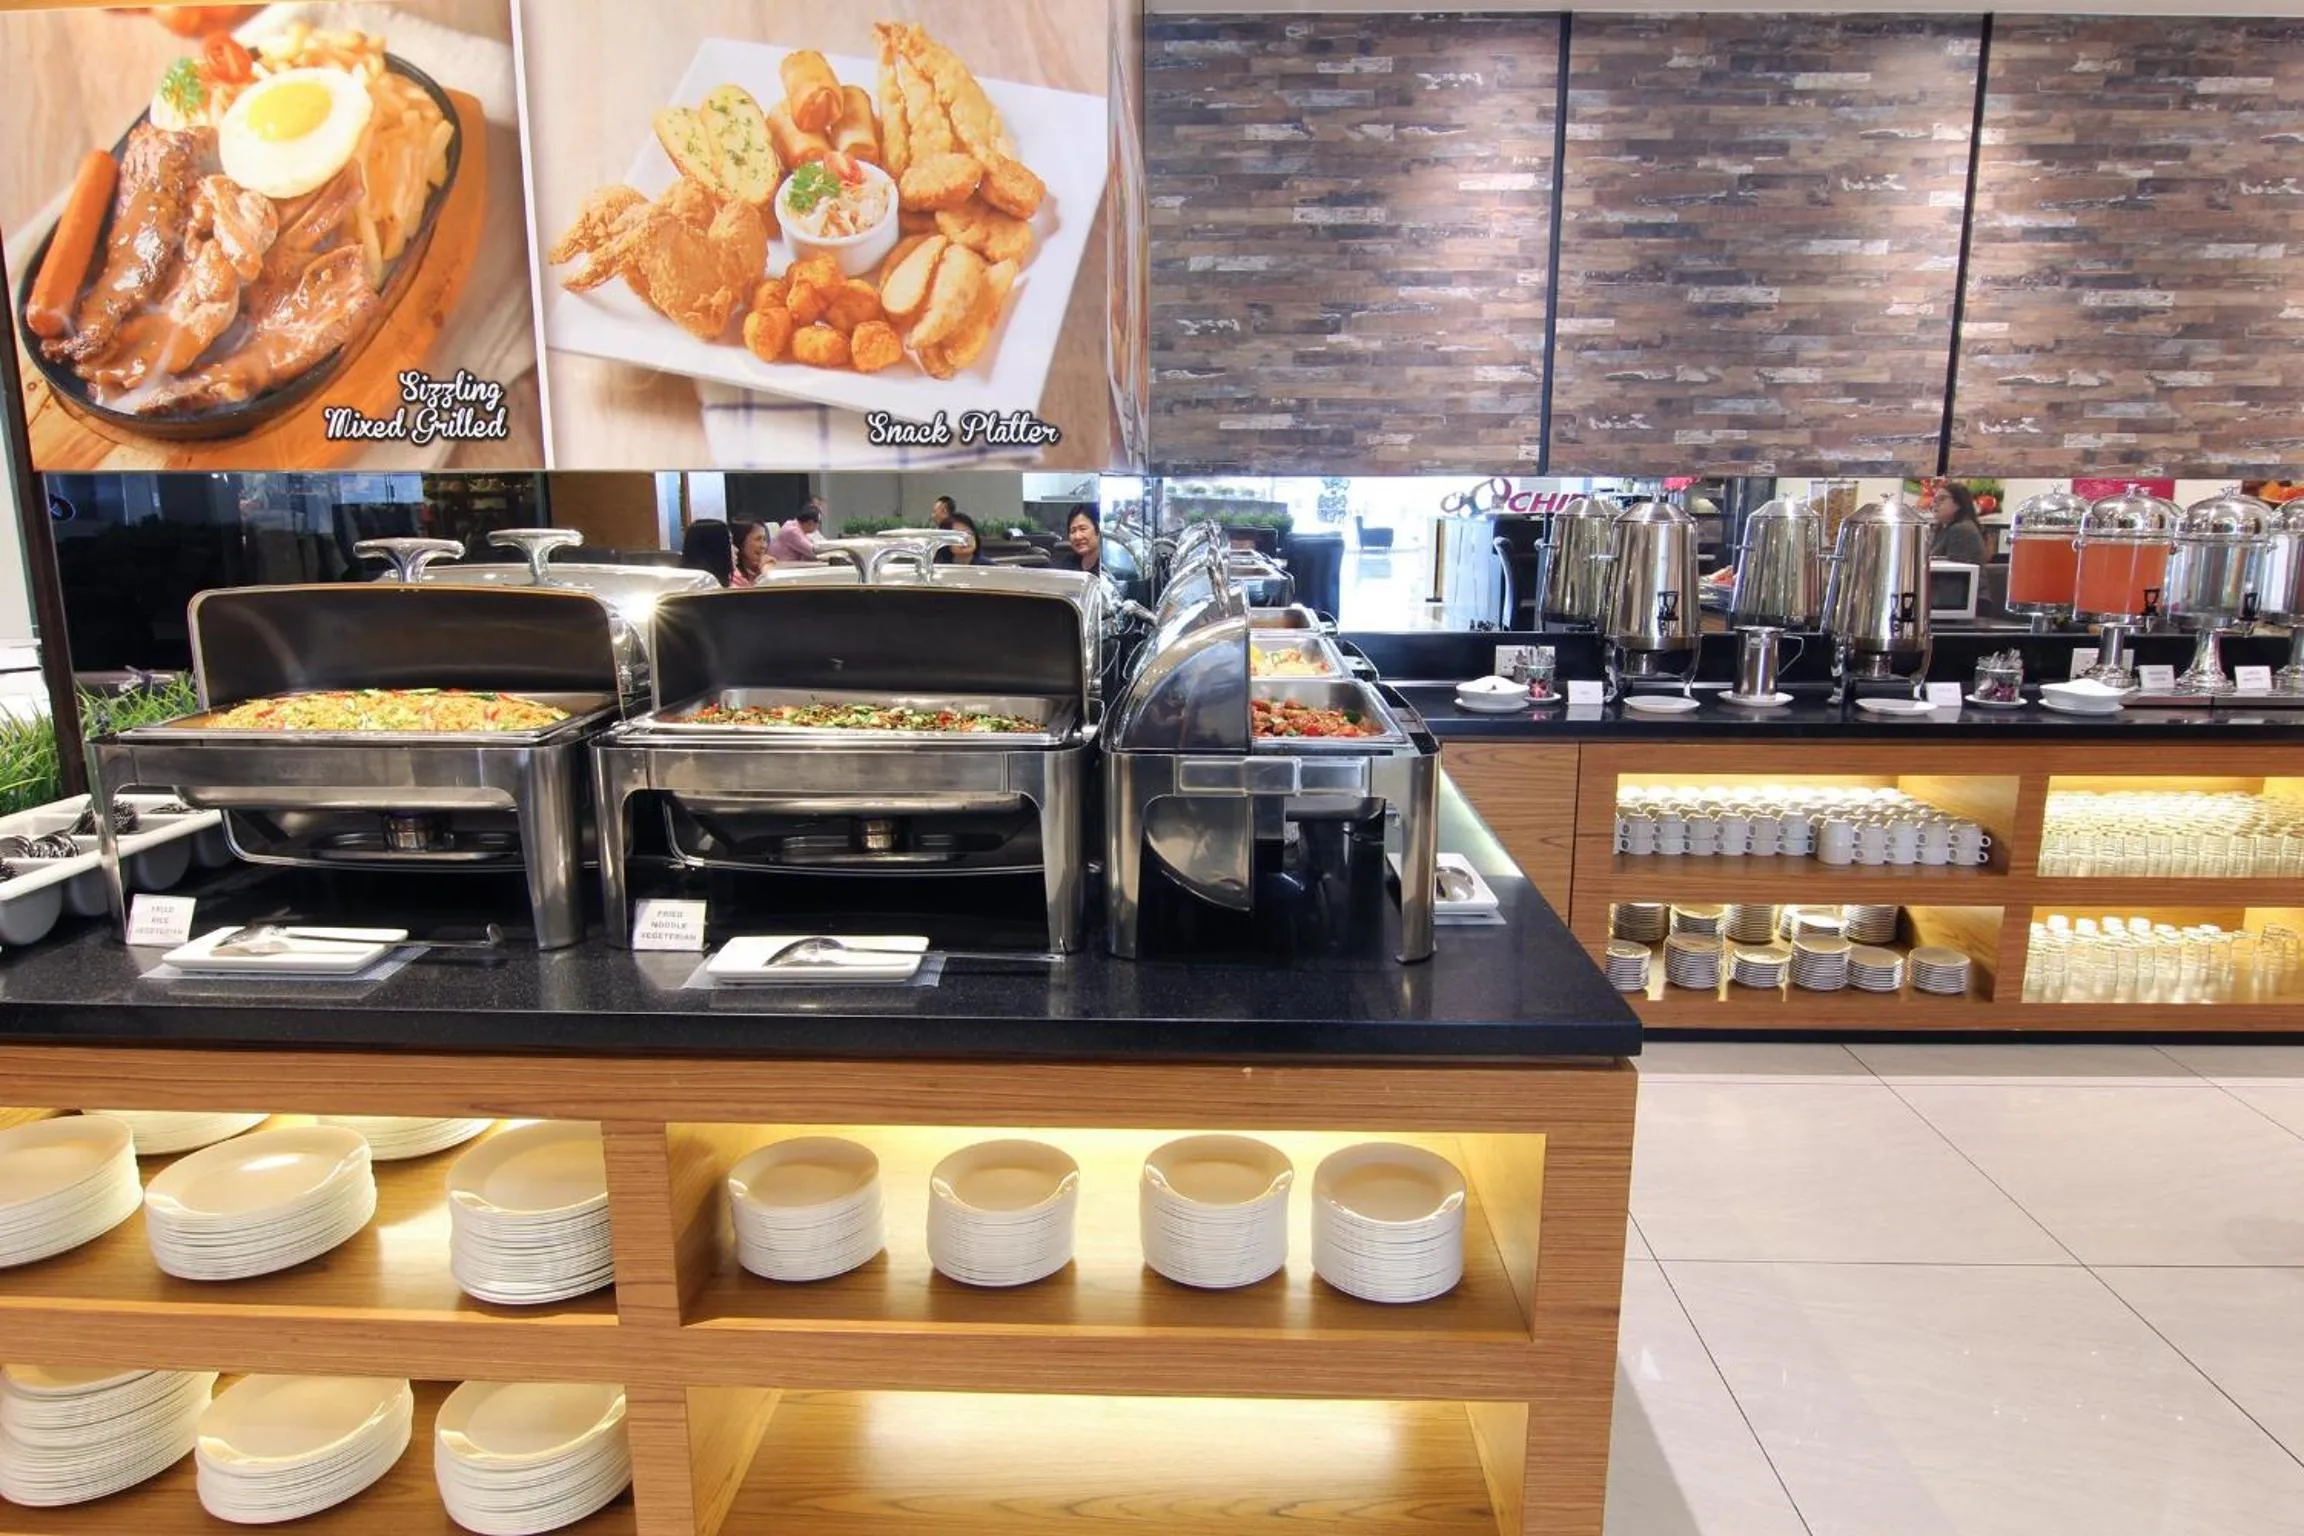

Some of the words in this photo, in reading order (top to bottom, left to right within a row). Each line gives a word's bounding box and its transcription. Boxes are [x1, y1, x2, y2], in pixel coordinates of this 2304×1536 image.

[399, 369, 503, 411] Sizzling
[325, 407, 407, 439] Mixed
[411, 406, 507, 444] Grilled
[867, 411, 951, 443] Snack
[960, 411, 1060, 443] Platter
[1507, 491, 1588, 513] CHI
